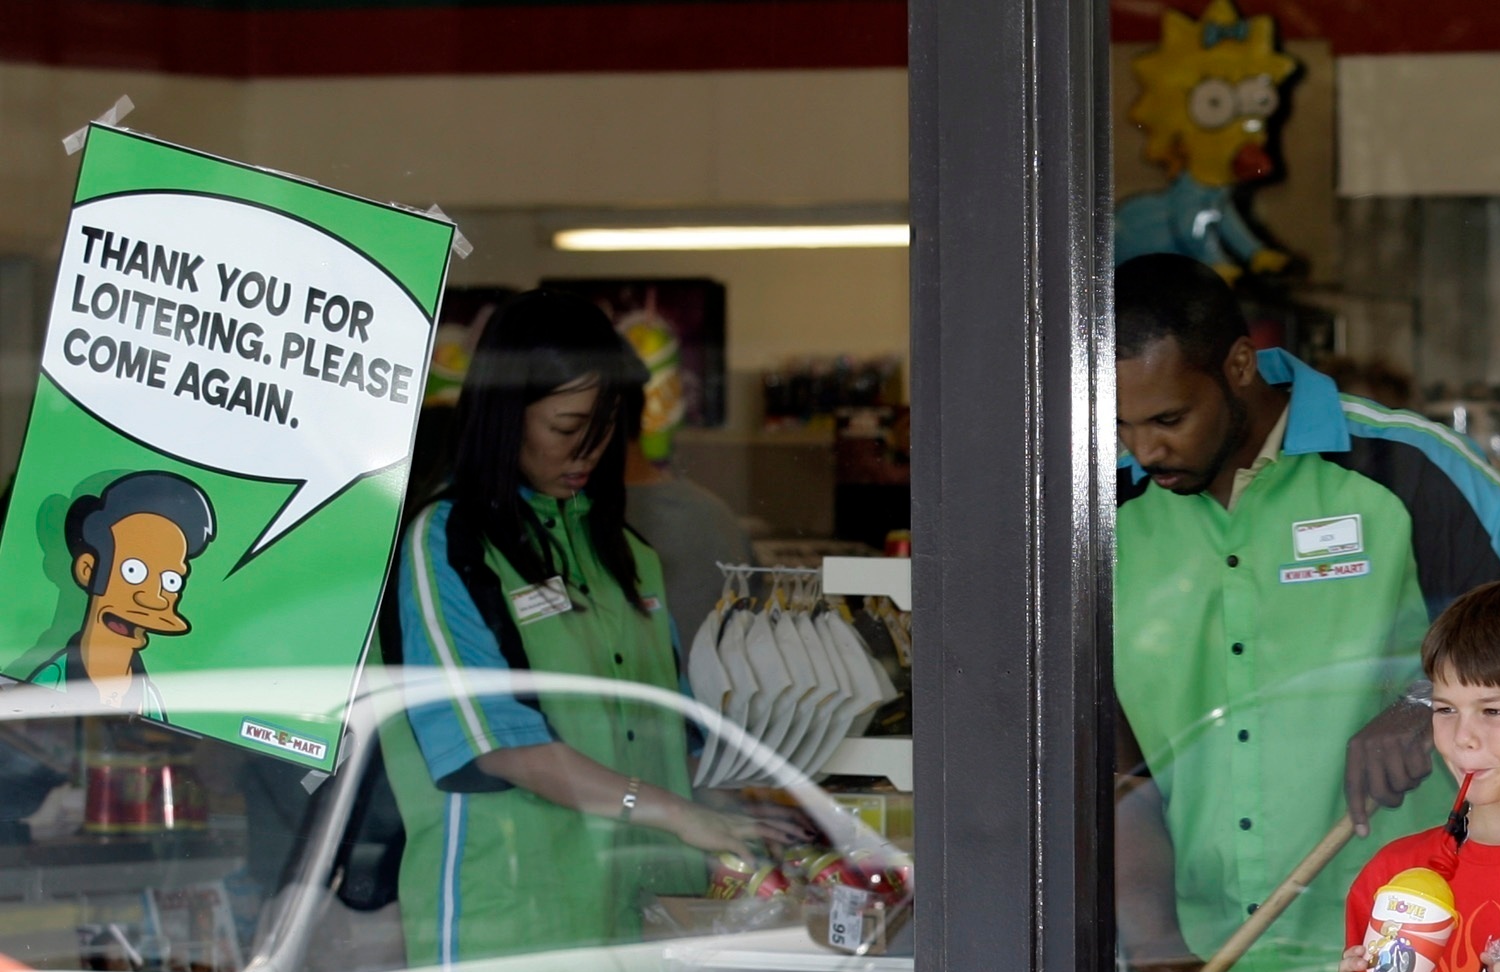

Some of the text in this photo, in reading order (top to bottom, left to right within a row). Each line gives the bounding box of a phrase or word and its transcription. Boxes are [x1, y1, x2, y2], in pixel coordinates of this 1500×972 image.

[81, 226, 374, 344] THANK YOU FOR
[63, 328, 300, 429] COME AGAIN.
[71, 275, 413, 405] LOITERING. PLEASE
[245, 724, 322, 756] KWIK-E-MART
